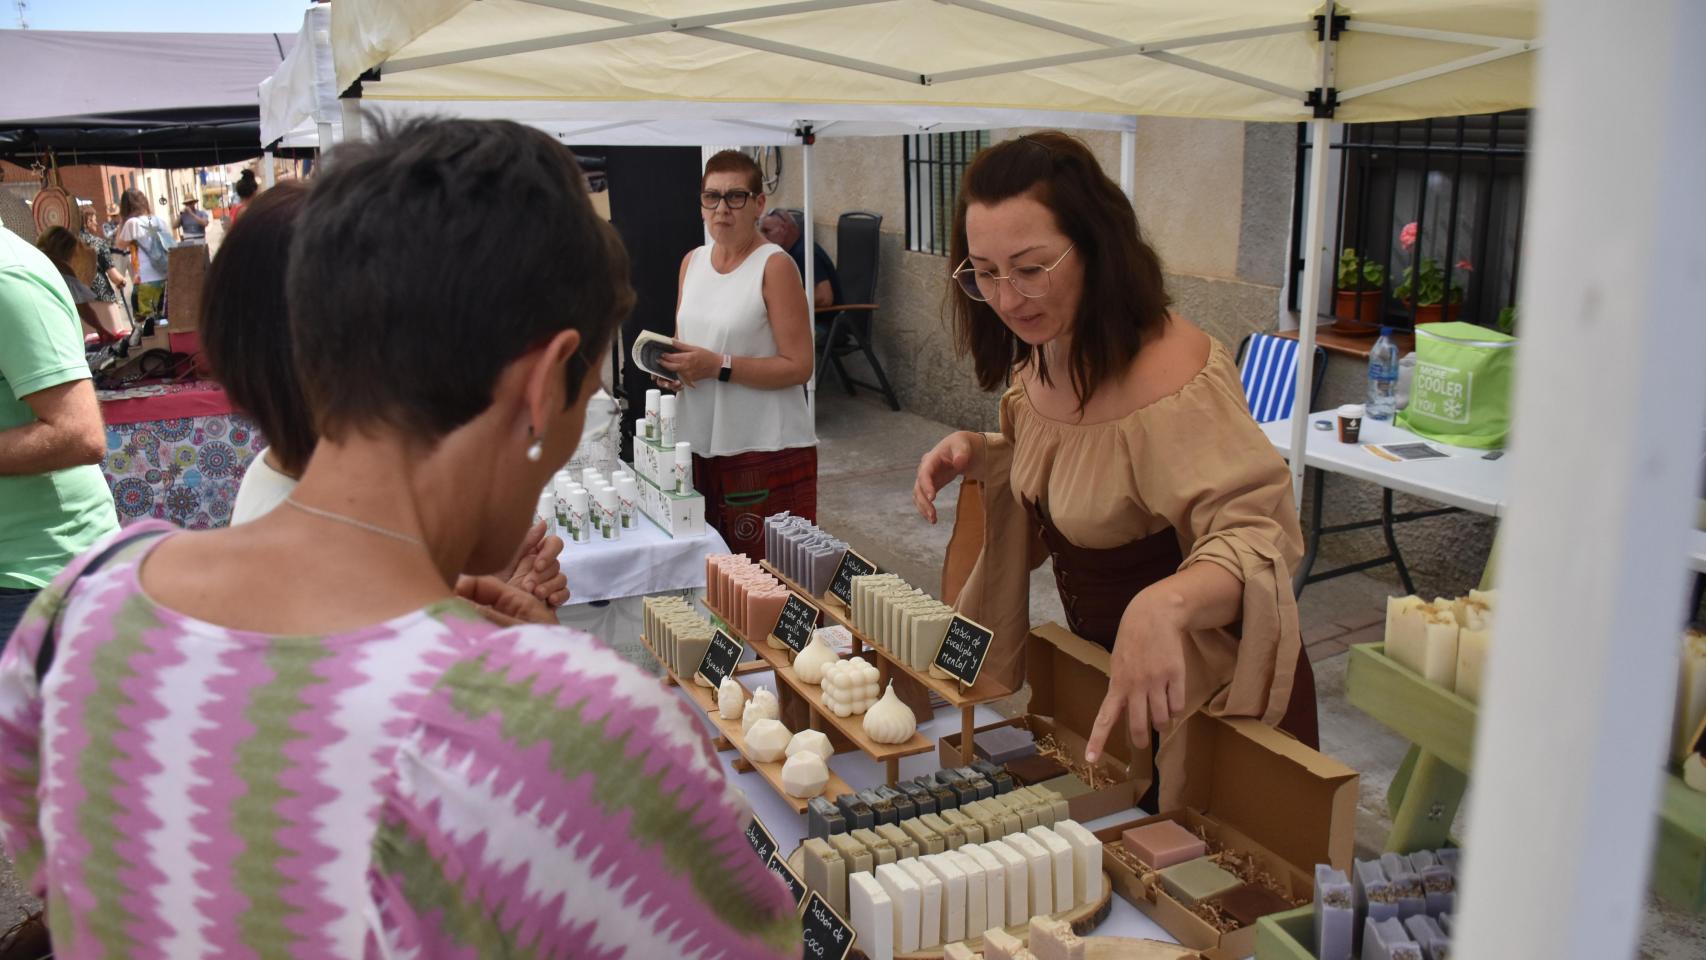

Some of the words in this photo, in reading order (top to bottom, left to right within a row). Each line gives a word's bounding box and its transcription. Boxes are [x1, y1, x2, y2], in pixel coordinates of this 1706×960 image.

[1417, 374, 1463, 399] COOLER
[951, 621, 971, 641] Jabón
[971, 635, 982, 648] de
[941, 652, 968, 673] Mentol
[746, 825, 759, 848] abón
[812, 900, 833, 930] Jabón
[832, 926, 844, 943] de
[803, 928, 824, 955] Coco
